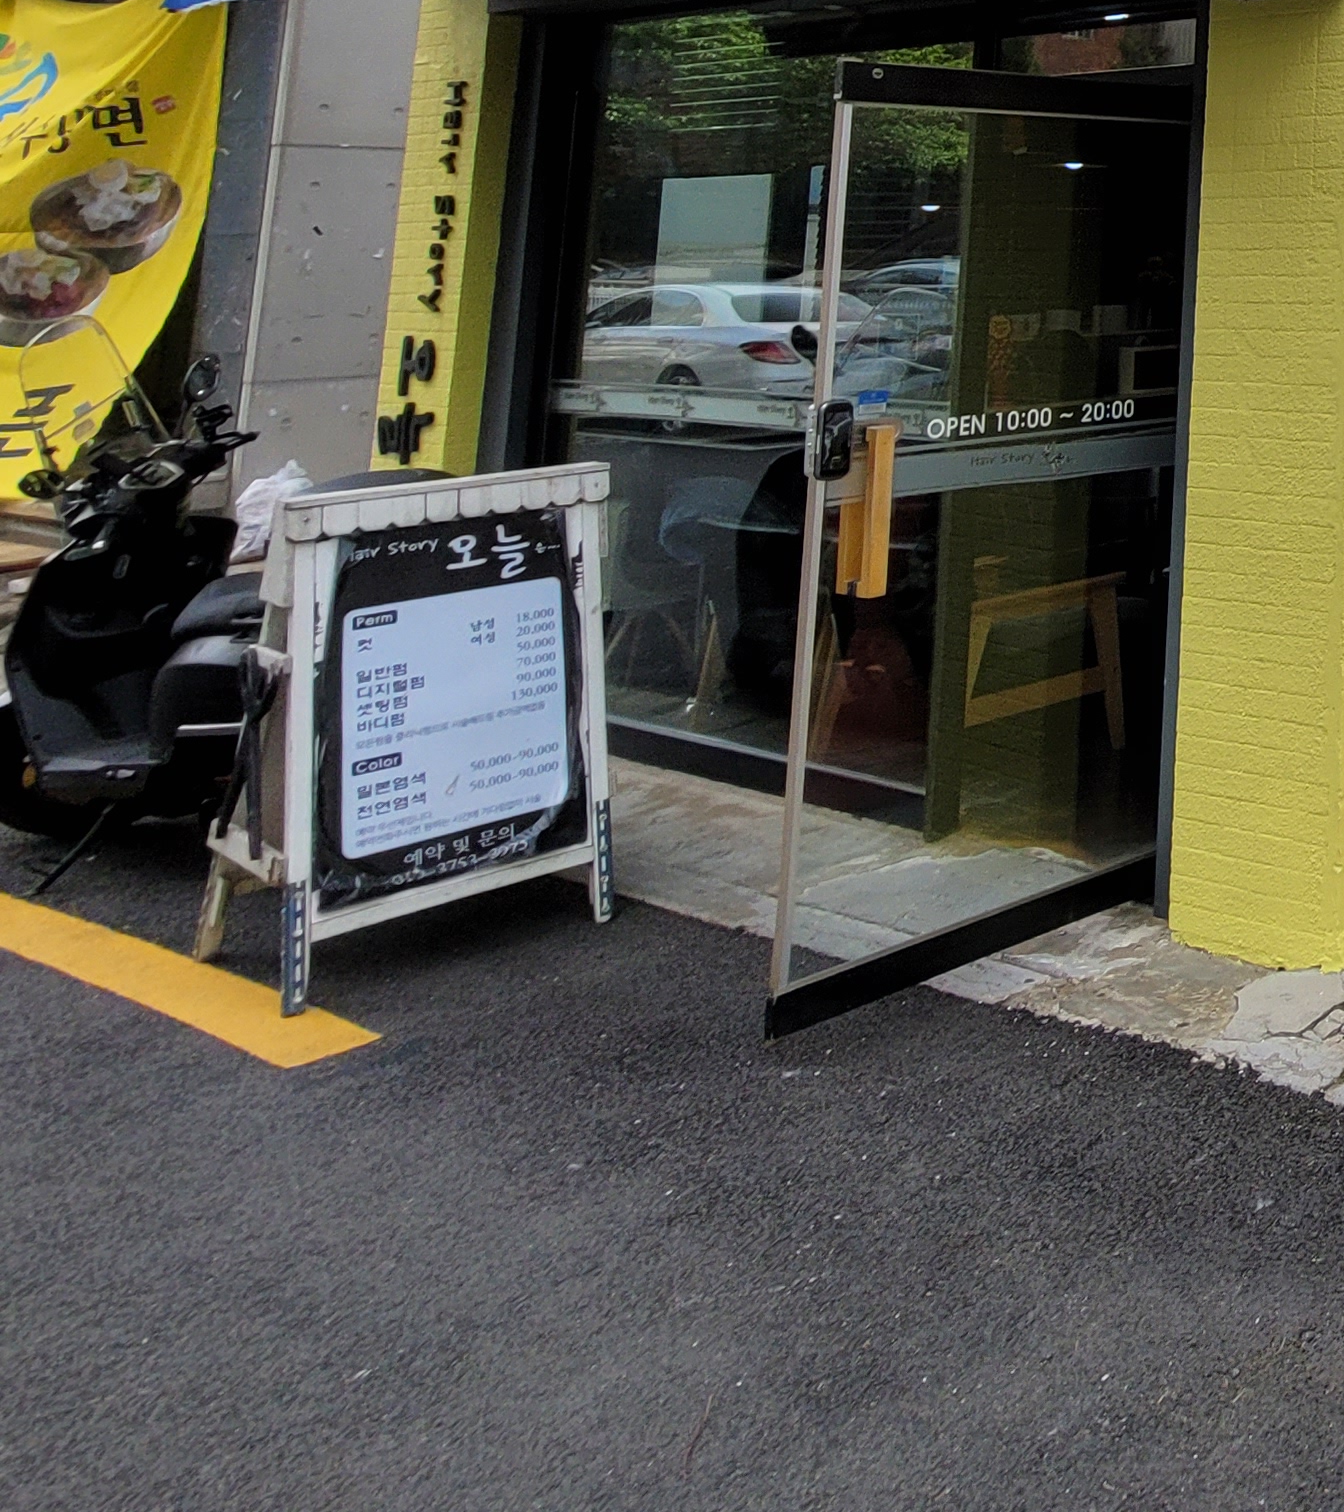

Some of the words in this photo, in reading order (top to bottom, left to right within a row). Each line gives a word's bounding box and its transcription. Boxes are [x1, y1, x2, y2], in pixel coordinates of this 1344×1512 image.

[439, 81, 468, 174] Hair
[417, 195, 456, 313] Story
[926, 414, 987, 440] OPEN
[995, 407, 1052, 432] 10:00
[1081, 399, 1135, 423] 20:00
[387, 538, 439, 556] Story
[355, 612, 395, 629] Perm
[470, 618, 495, 632] 남성
[470, 632, 496, 646] 여성
[356, 663, 408, 684] 일반펌
[356, 713, 406, 732] 바디펌
[355, 756, 400, 773] Color
[403, 843, 445, 866] 예약
[453, 835, 470, 853] 및
[477, 823, 515, 848] 문의
